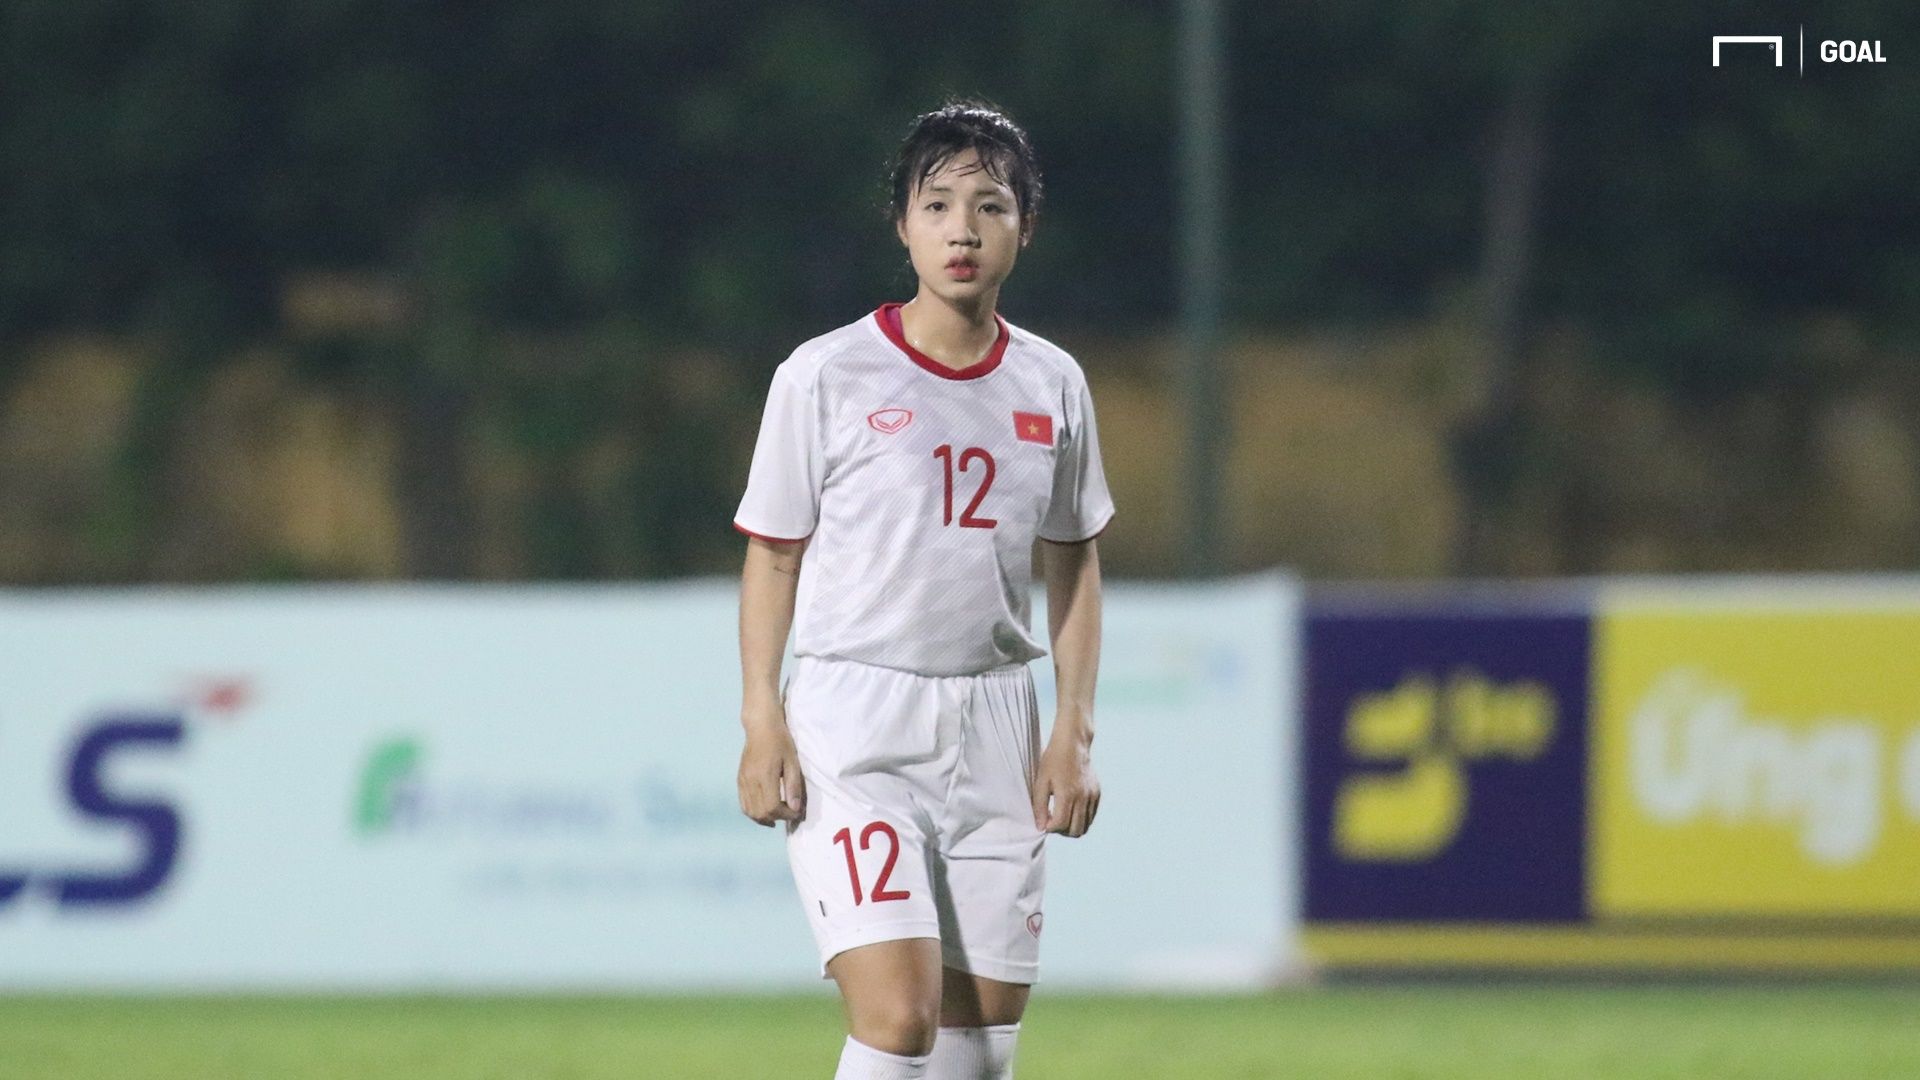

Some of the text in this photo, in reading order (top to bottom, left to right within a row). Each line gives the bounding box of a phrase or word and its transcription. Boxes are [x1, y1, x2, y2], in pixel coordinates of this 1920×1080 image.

[933, 444, 998, 529] 12
[0, 711, 188, 910] S
[833, 821, 911, 906] 12
